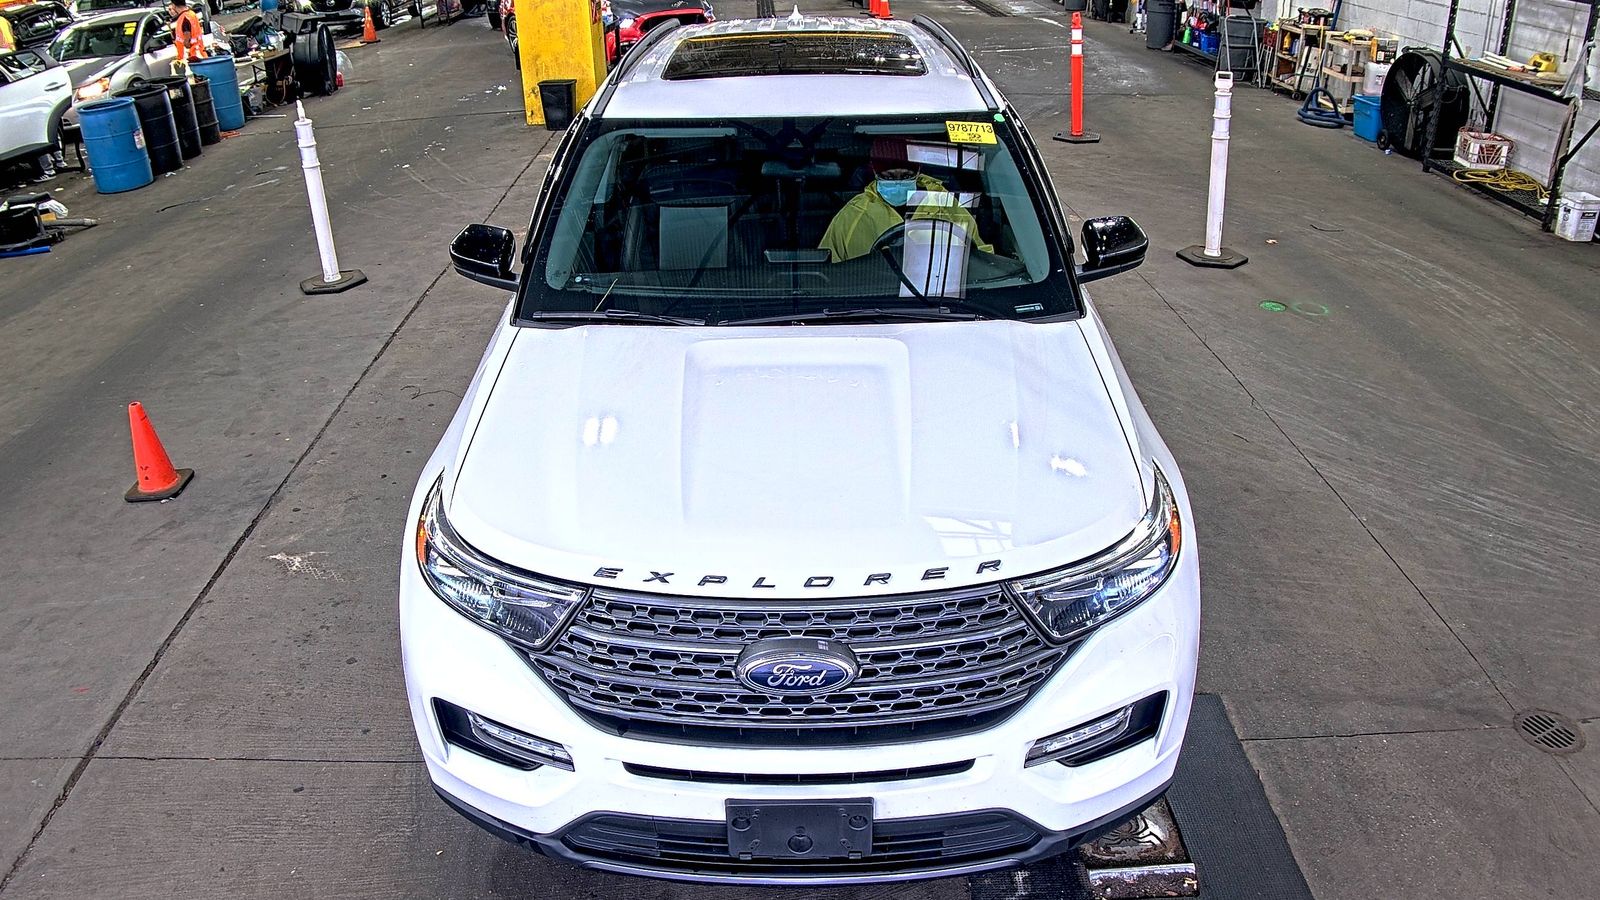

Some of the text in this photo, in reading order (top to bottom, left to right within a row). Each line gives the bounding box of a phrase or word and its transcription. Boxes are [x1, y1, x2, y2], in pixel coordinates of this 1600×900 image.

[948, 123, 993, 134] 9787713
[593, 559, 1002, 588] EXPLORER
[767, 664, 827, 686] Ford
